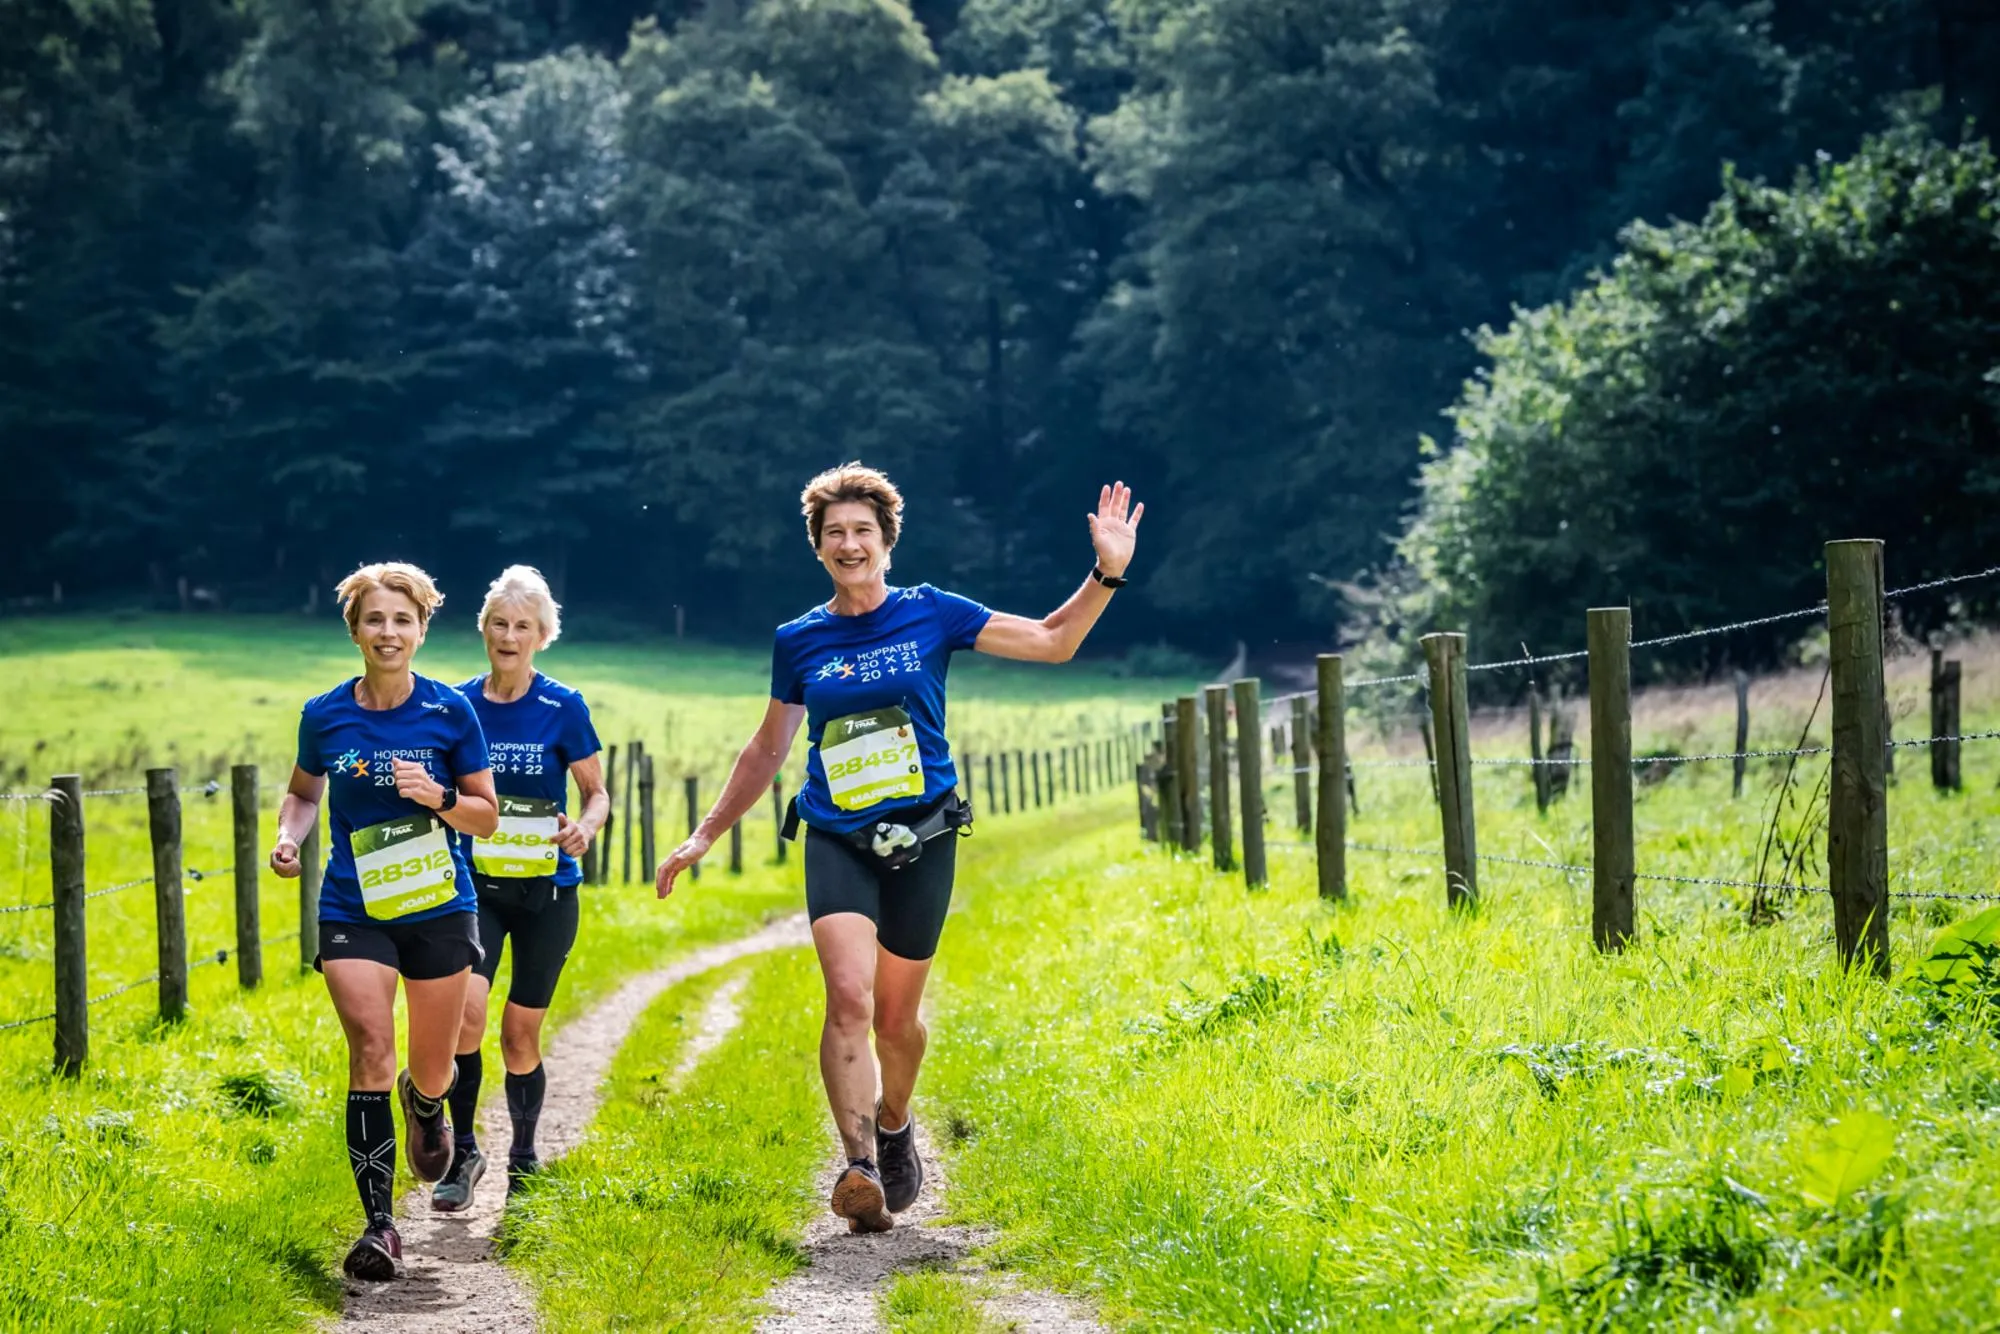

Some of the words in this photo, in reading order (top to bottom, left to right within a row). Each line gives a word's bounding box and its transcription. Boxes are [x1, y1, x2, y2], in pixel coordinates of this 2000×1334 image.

[857, 641, 918, 662] HOPPATEE
[860, 660, 879, 671] 20
[901, 650, 919, 661] 21
[860, 670, 881, 683] 20
[904, 660, 921, 672] 22
[844, 720, 854, 734] 7
[490, 742, 545, 752] HOPPATEE
[374, 749, 433, 760] HOPPATEE
[489, 752, 507, 761] 20
[525, 753, 542, 763] 21
[828, 743, 917, 780] 28457
[374, 761, 394, 772] 20
[490, 763, 506, 773] 20
[525, 764, 543, 775] 22
[374, 775, 395, 787] 20
[503, 800, 513, 812] 7
[382, 827, 391, 841] 7
[362, 849, 452, 889] 28312
[397, 892, 437, 911] JOAN
